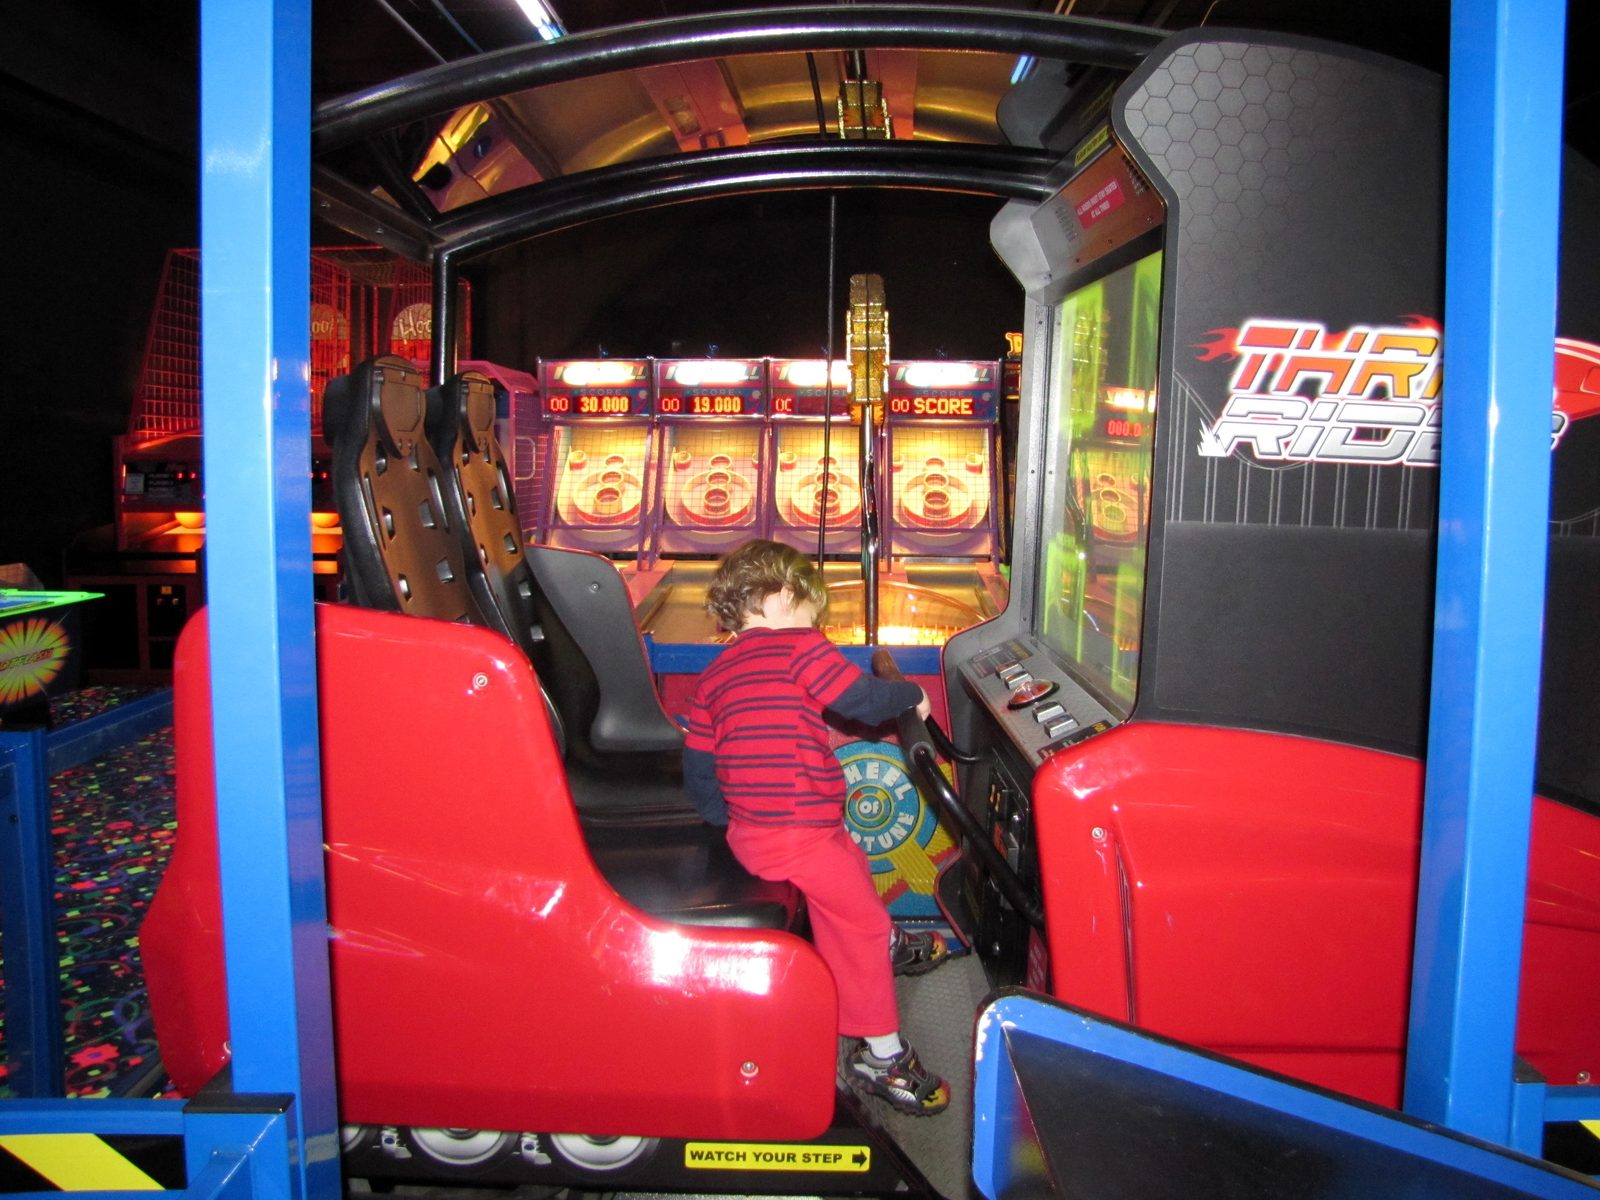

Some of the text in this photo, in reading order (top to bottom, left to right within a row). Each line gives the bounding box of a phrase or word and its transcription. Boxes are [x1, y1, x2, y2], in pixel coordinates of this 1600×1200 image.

[1232, 325, 1443, 399] THR
[580, 388, 622, 396] SCORE
[692, 388, 735, 396] SCORE
[806, 389, 847, 397] SCRE
[913, 397, 973, 415] SCORE
[843, 761, 912, 801] HEEL
[859, 801, 880, 815] OF
[690, 1150, 843, 1164] WATCH YOUR STEP
